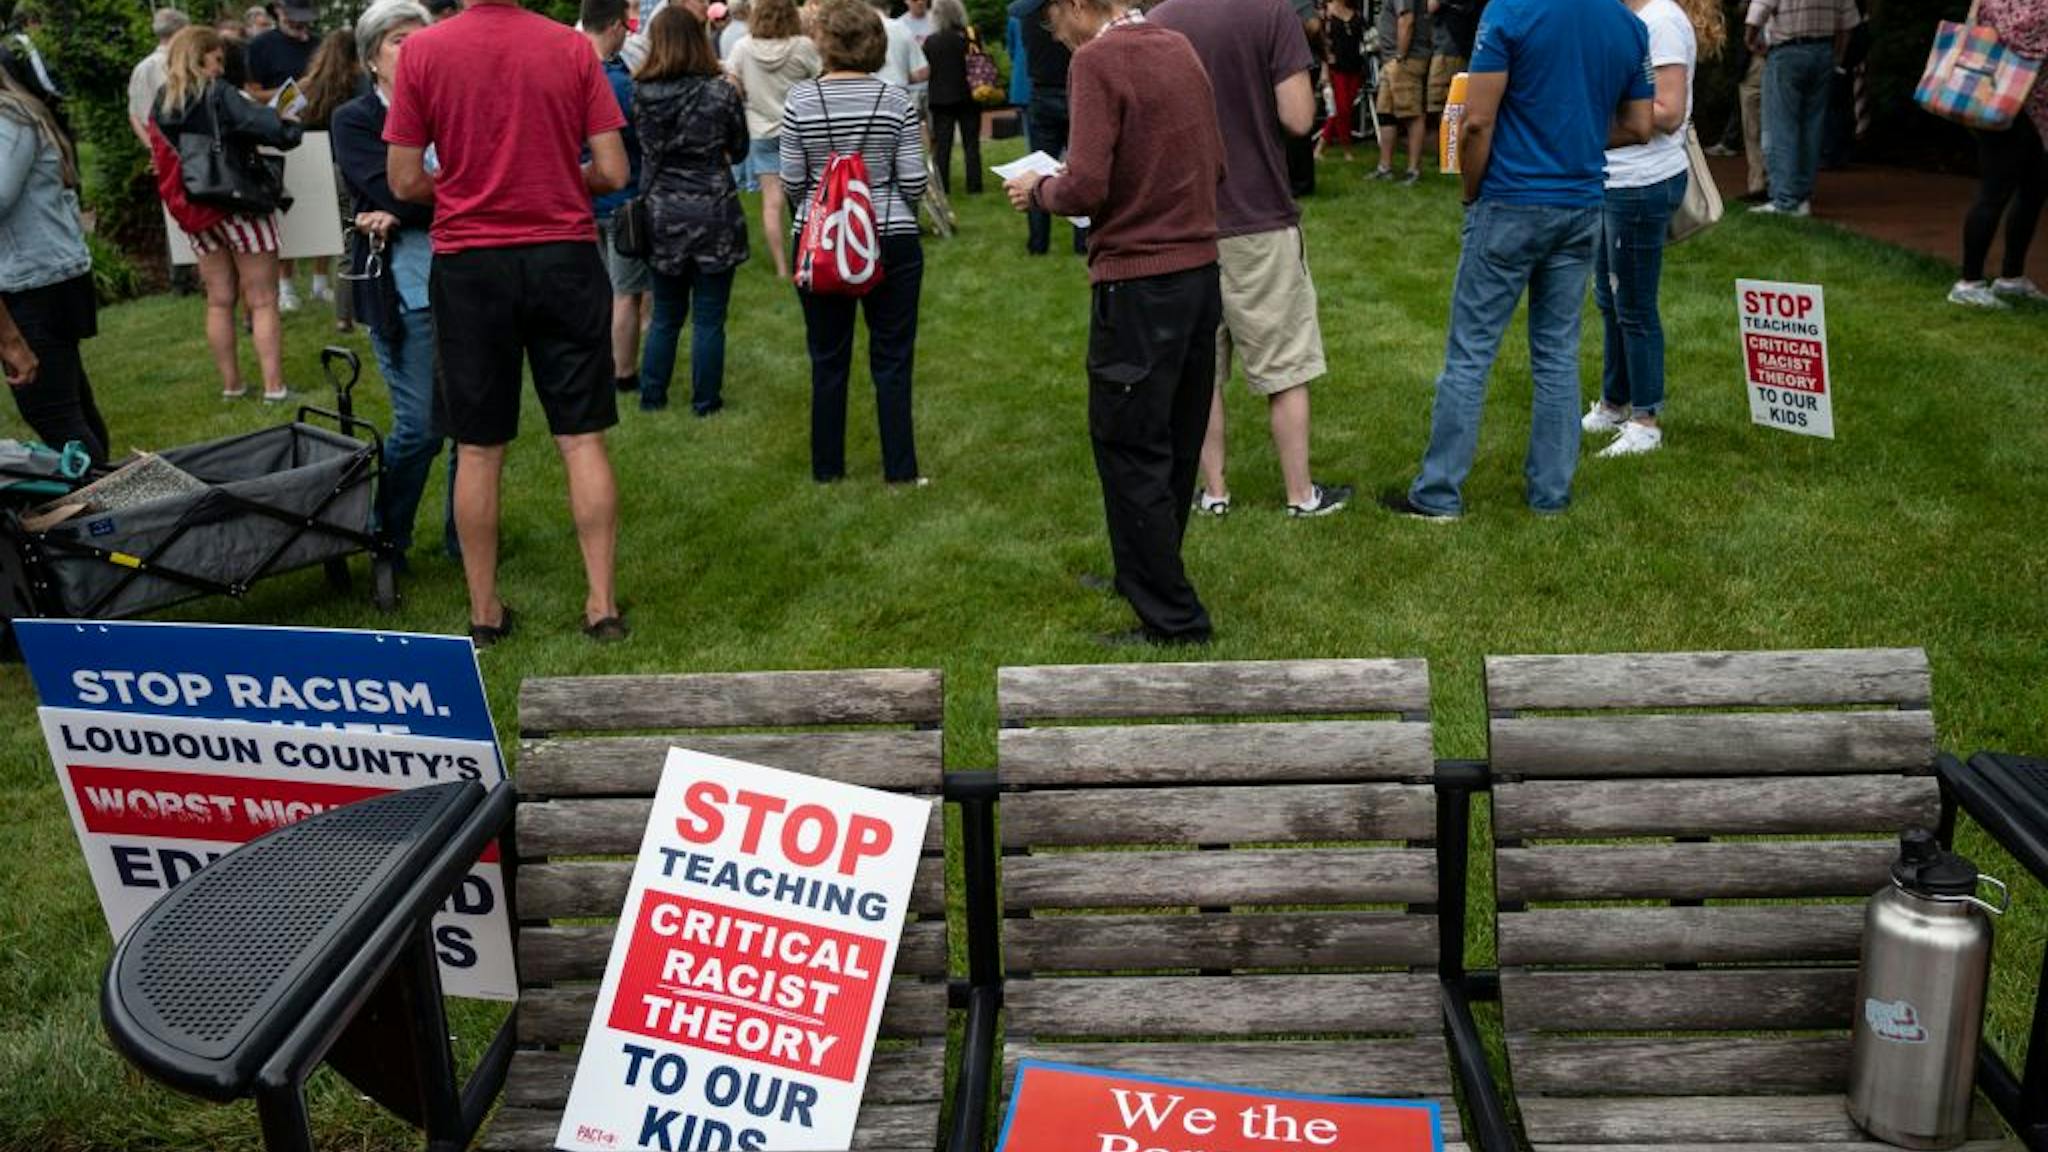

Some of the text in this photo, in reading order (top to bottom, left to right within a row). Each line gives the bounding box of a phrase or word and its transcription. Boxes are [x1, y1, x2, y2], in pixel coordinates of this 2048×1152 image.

[1743, 290, 1813, 320] STOP
[1744, 316, 1819, 336] TEACHING
[1749, 336, 1820, 358] CRITICAL
[1756, 351, 1813, 372] RACIST
[1756, 369, 1817, 390] THEORY
[1757, 387, 1818, 411] TO OUR
[1769, 407, 1808, 427] KIDS
[71, 670, 451, 717] STOP RACISM.
[60, 725, 260, 763] LOUDOUN
[274, 741, 482, 781] COUNTY'S
[675, 781, 893, 876] STOP
[659, 847, 888, 922] TEACHING
[650, 903, 869, 979] CRITICAL
[660, 949, 840, 1015] RACIST
[641, 995, 840, 1068] THEORY
[622, 1043, 819, 1128] TO OUR
[1109, 1088, 1217, 1135] We
[1238, 1103, 1338, 1145] the
